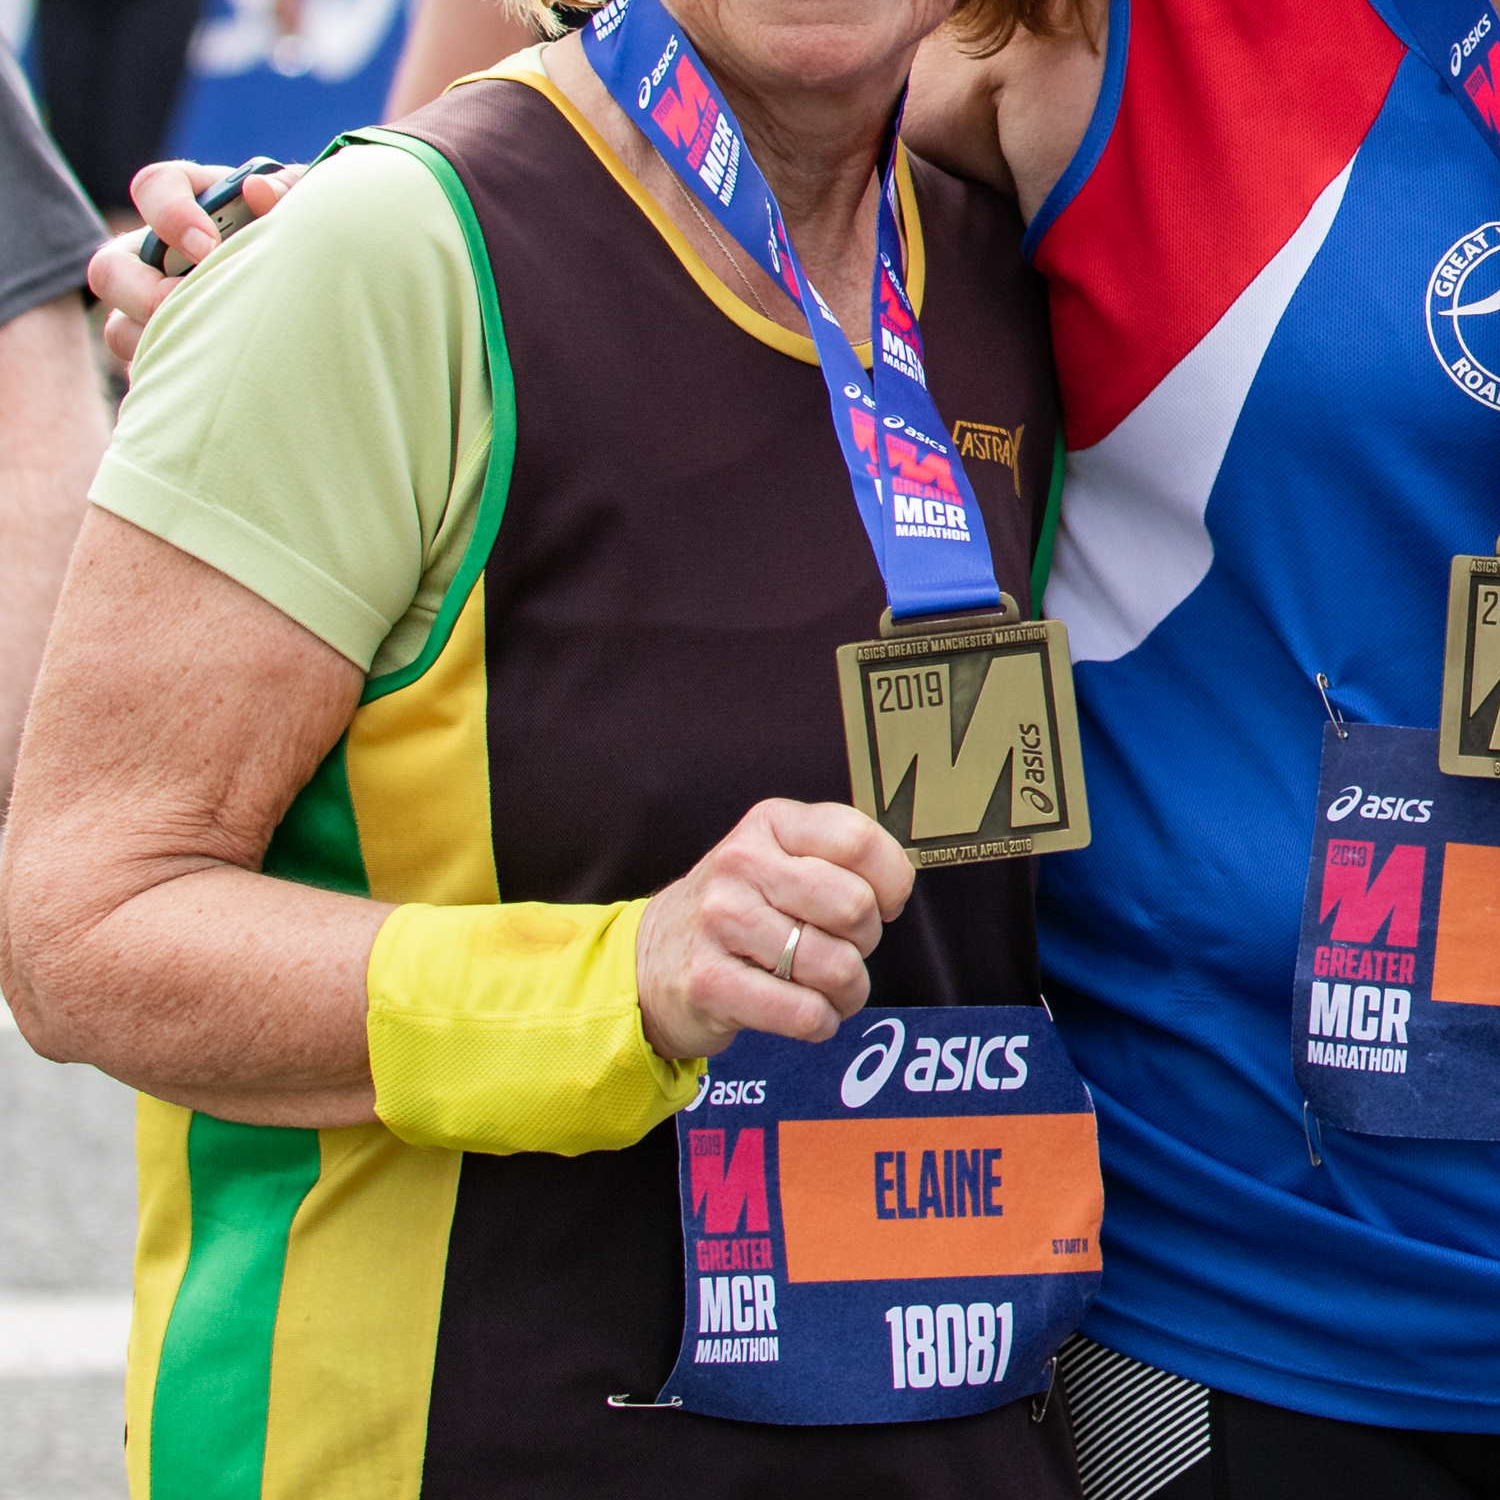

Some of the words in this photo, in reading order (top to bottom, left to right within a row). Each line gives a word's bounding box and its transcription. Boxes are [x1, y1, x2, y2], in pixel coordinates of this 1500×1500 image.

[656, 93, 676, 122] 2019
[686, 97, 719, 170] GREATER
[698, 112, 734, 195] MCR
[718, 133, 741, 207] MARATHON
[1434, 232, 1489, 297] GREAT
[893, 494, 969, 531] MCR
[895, 524, 971, 543] MARATHON
[1470, 560, 1498, 574] ASICS
[857, 644, 886, 662] ASICS
[888, 638, 928, 658] GREATER
[930, 632, 993, 653] MANCHESTER
[995, 626, 1047, 645] MARATHON
[876, 670, 944, 714] 2019
[920, 847, 959, 866] SUNDAY
[959, 845, 978, 861] 7TH
[980, 841, 1008, 858] APRIL
[1330, 844, 1368, 868] 2019
[1313, 945, 1416, 985] GREATER
[1308, 981, 1412, 1044] MCR
[1307, 1040, 1408, 1074] MARATHON
[692, 1134, 721, 1157] 2019
[873, 1147, 1003, 1221] ELAINE
[696, 1238, 773, 1272] GREATER
[1051, 1238, 1080, 1256] START
[1081, 1238, 1089, 1254] H
[698, 1275, 778, 1333] MCR
[694, 1336, 779, 1363] MARATHON
[884, 1301, 1014, 1390] 18081
